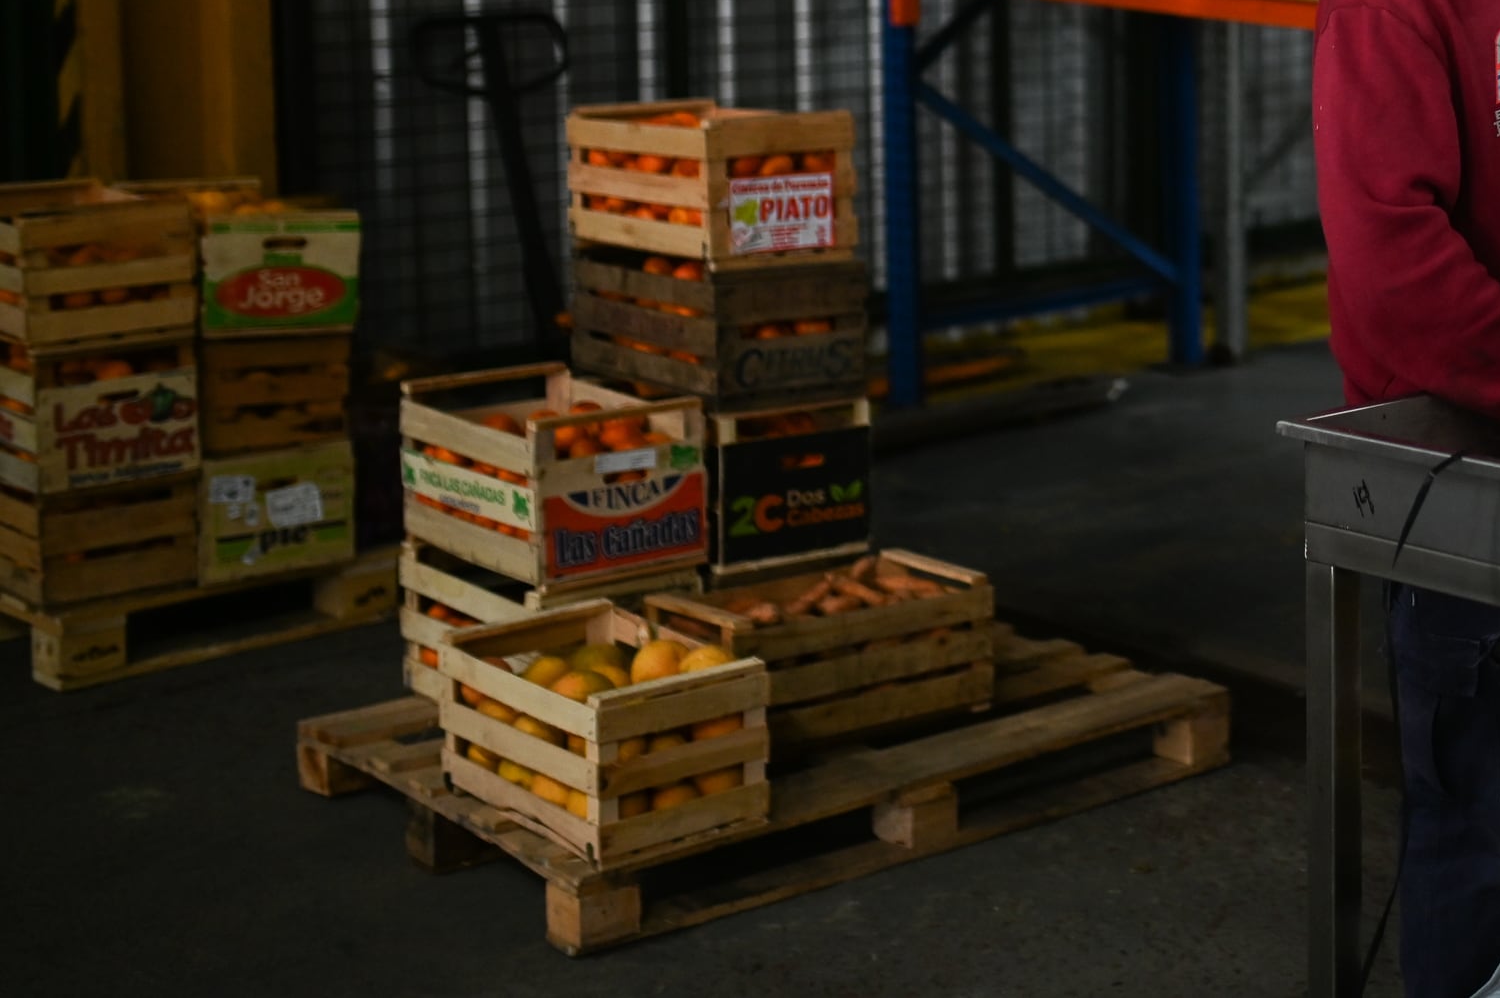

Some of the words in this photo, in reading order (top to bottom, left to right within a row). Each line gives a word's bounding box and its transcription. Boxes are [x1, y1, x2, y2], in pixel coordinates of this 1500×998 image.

[760, 195, 828, 224] PIATO
[258, 269, 302, 287] San
[237, 284, 324, 314] Jorge
[736, 338, 853, 388] CITRUS
[443, 476, 461, 494] LAS
[591, 479, 661, 510] FINCA
[786, 488, 826, 508] Dos
[728, 493, 785, 538] 2C
[555, 529, 597, 568] Las
[602, 508, 700, 559] Cañadas
